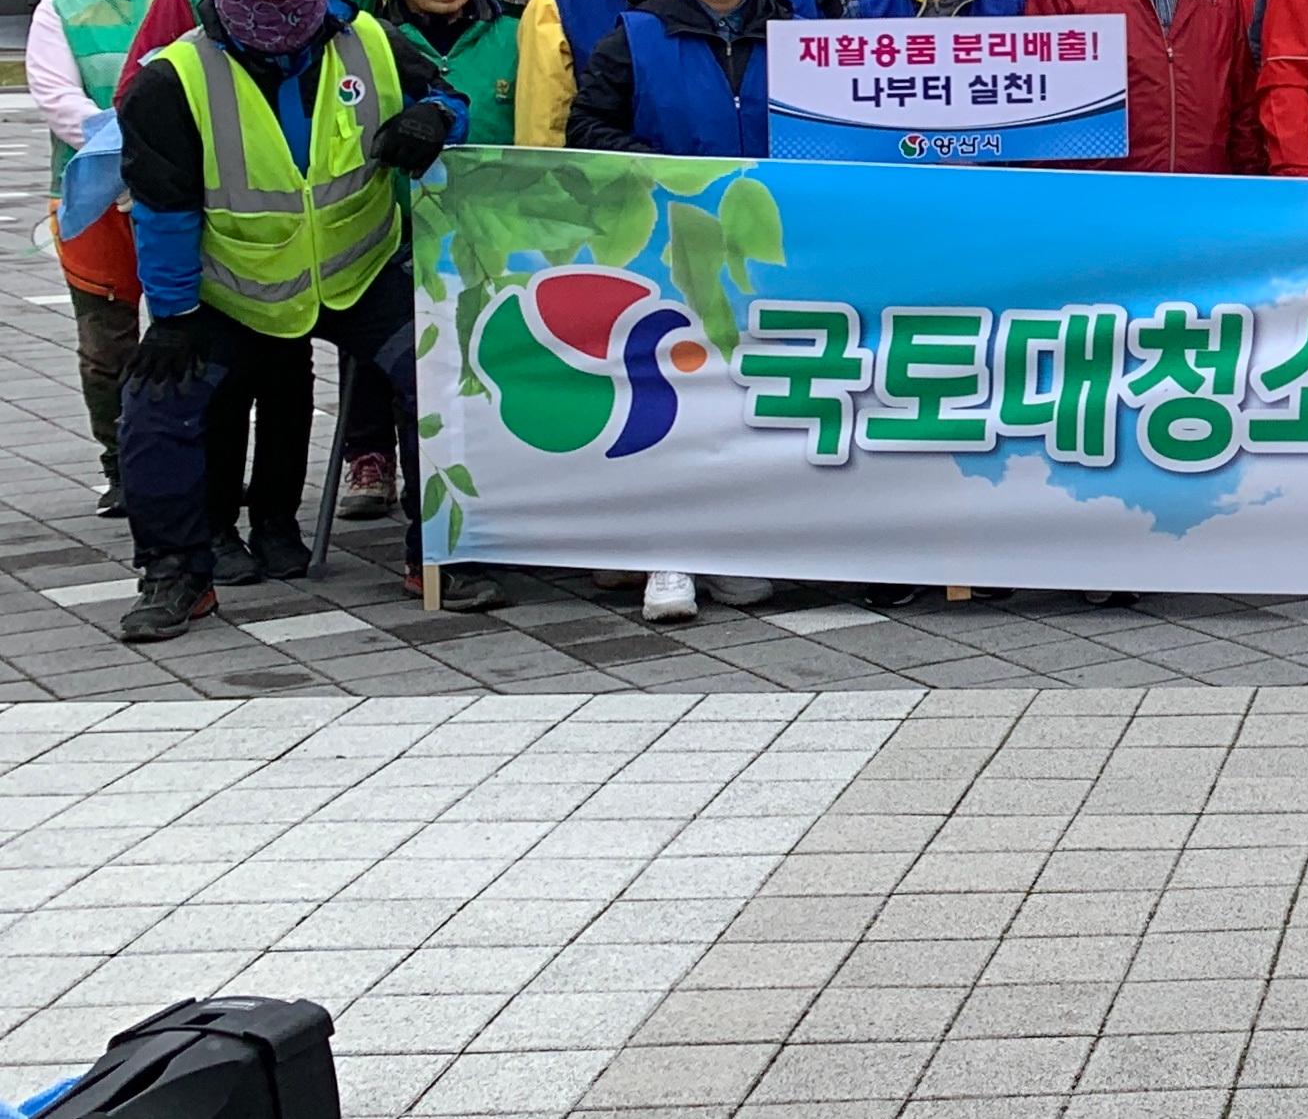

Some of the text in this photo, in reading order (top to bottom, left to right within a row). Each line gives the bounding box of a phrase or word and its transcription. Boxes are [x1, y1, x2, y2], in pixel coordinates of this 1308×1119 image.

[799, 31, 1099, 68] 재활용품 분리배출!
[852, 73, 1047, 107] 나부터 실천!
[932, 134, 1002, 157] 양산시
